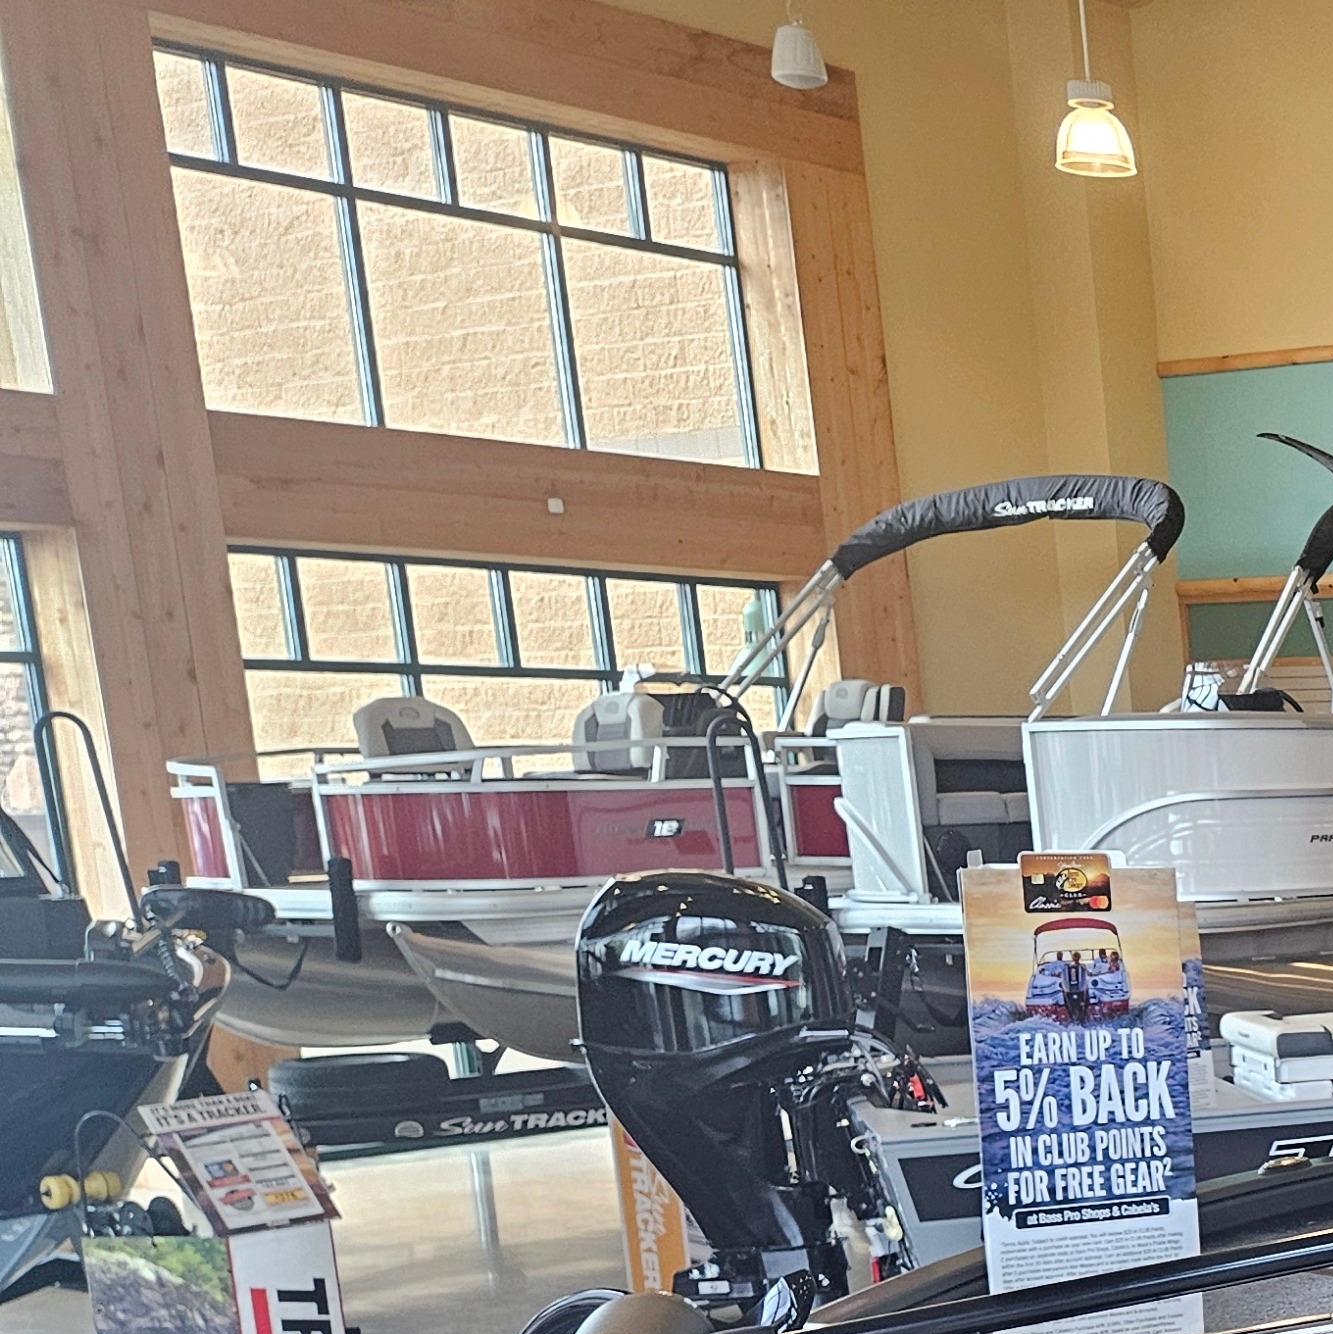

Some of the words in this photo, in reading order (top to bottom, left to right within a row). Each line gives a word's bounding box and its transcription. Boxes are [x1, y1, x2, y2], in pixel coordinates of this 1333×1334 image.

[620, 939, 799, 977] MERCURY
[1019, 1030, 1076, 1066] EARN
[1084, 1028, 1112, 1062] UP
[1117, 1027, 1145, 1060] TO
[993, 1067, 1059, 1132] 5%
[1069, 1060, 1176, 1127] BACK
[1009, 1135, 1033, 1169] IN
[1037, 1131, 1090, 1166] CLUB
[1095, 1125, 1168, 1162] POINTS
[1007, 1169, 1051, 1206] FOR
[1054, 1164, 1107, 1201] FREE
[1026, 1213, 1038, 1225] at
[1039, 1211, 1063, 1224] Bass
[1064, 1210, 1081, 1222] Pro
[1082, 1206, 1111, 1220] Shops
[1112, 1204, 1120, 1217] &
[1121, 1201, 1160, 1216] Cabela's
